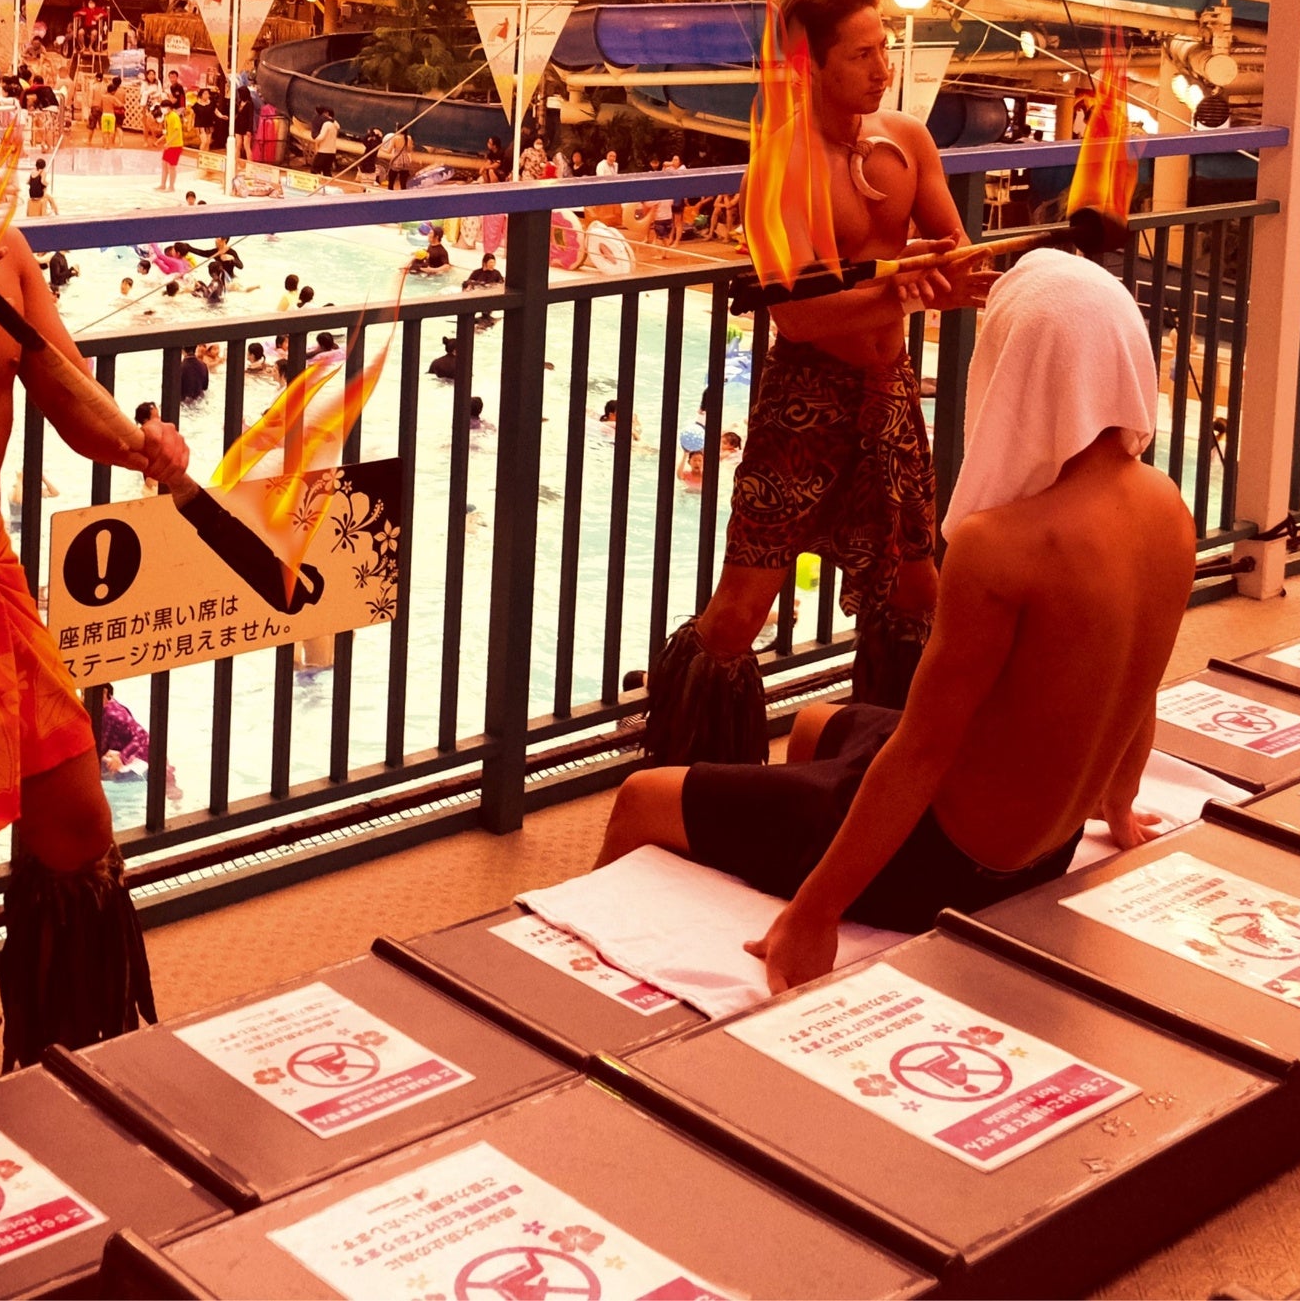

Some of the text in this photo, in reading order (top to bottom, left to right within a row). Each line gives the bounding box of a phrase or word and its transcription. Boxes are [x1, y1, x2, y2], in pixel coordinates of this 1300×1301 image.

[59, 595, 239, 650] 座席面が黒い席は
[64, 617, 293, 680] ステージが見えません。
[311, 1068, 452, 1126] こちらはご利用できません
[337, 1074, 412, 1106] Not available
[959, 1076, 1110, 1153] こちらはご利用できません
[979, 1084, 1062, 1126] Not available
[6, 1215, 36, 1230] Not
